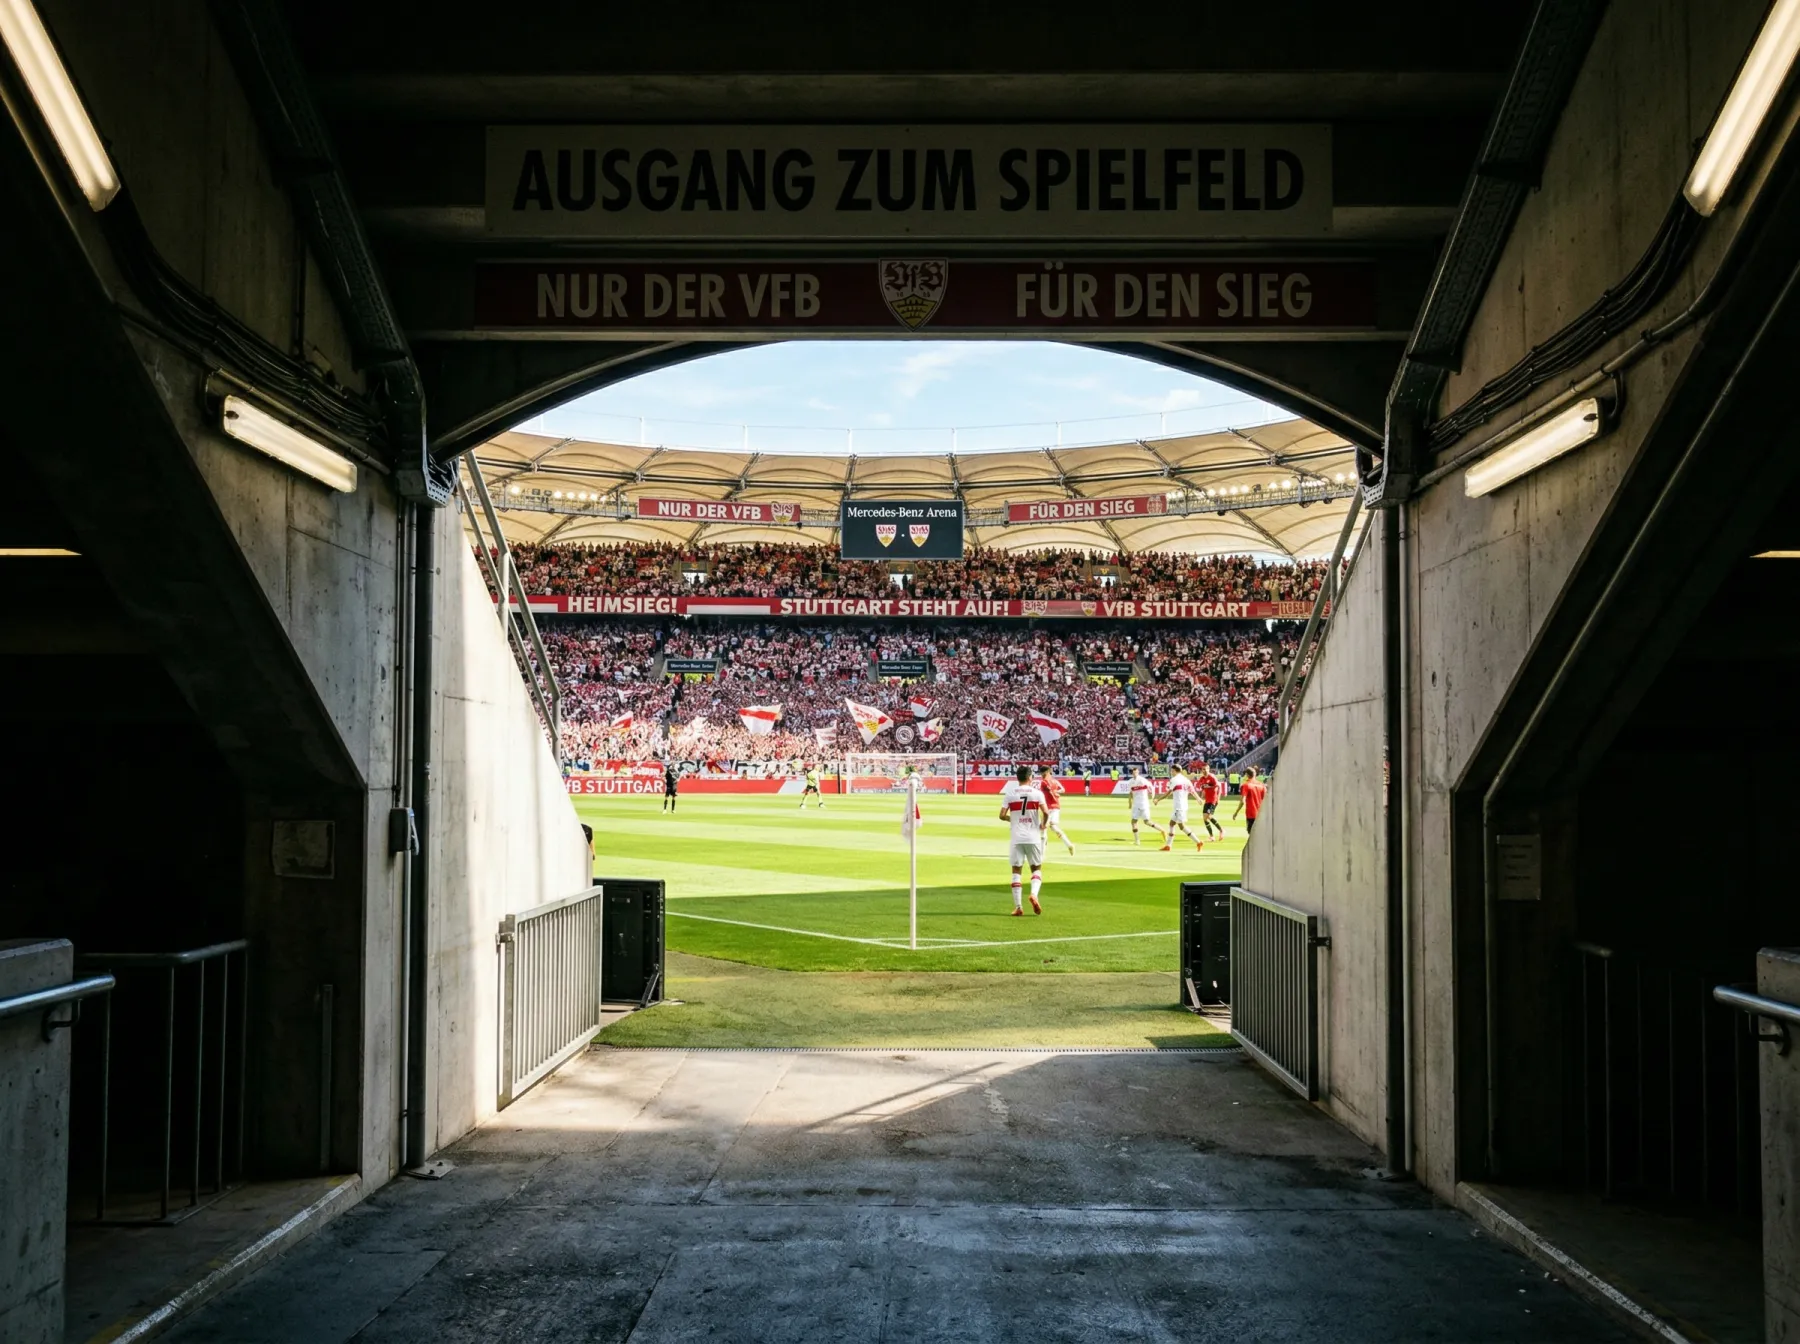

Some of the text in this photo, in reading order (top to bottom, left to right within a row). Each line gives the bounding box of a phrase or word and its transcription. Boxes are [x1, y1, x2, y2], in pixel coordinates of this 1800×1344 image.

[512, 147, 1305, 212] AUSGANG ZUM SPIELFELD
[537, 273, 821, 318] NUR DER VFB
[1016, 260, 1313, 318] FÜR DEN SIEG
[658, 501, 692, 517] NUR
[696, 503, 727, 519] DER
[731, 504, 762, 520] VFB
[847, 506, 958, 518] Mercedes-Benz Arena
[1063, 502, 1095, 517] DEN
[1099, 499, 1135, 515] SIEG
[567, 596, 677, 613] HEIMSIEG!
[780, 598, 894, 615] STUTTGART
[898, 600, 960, 616] STEHT
[963, 600, 1009, 616] AUF!
[1103, 601, 1136, 617] VfB
[1019, 796, 1028, 816] 7
